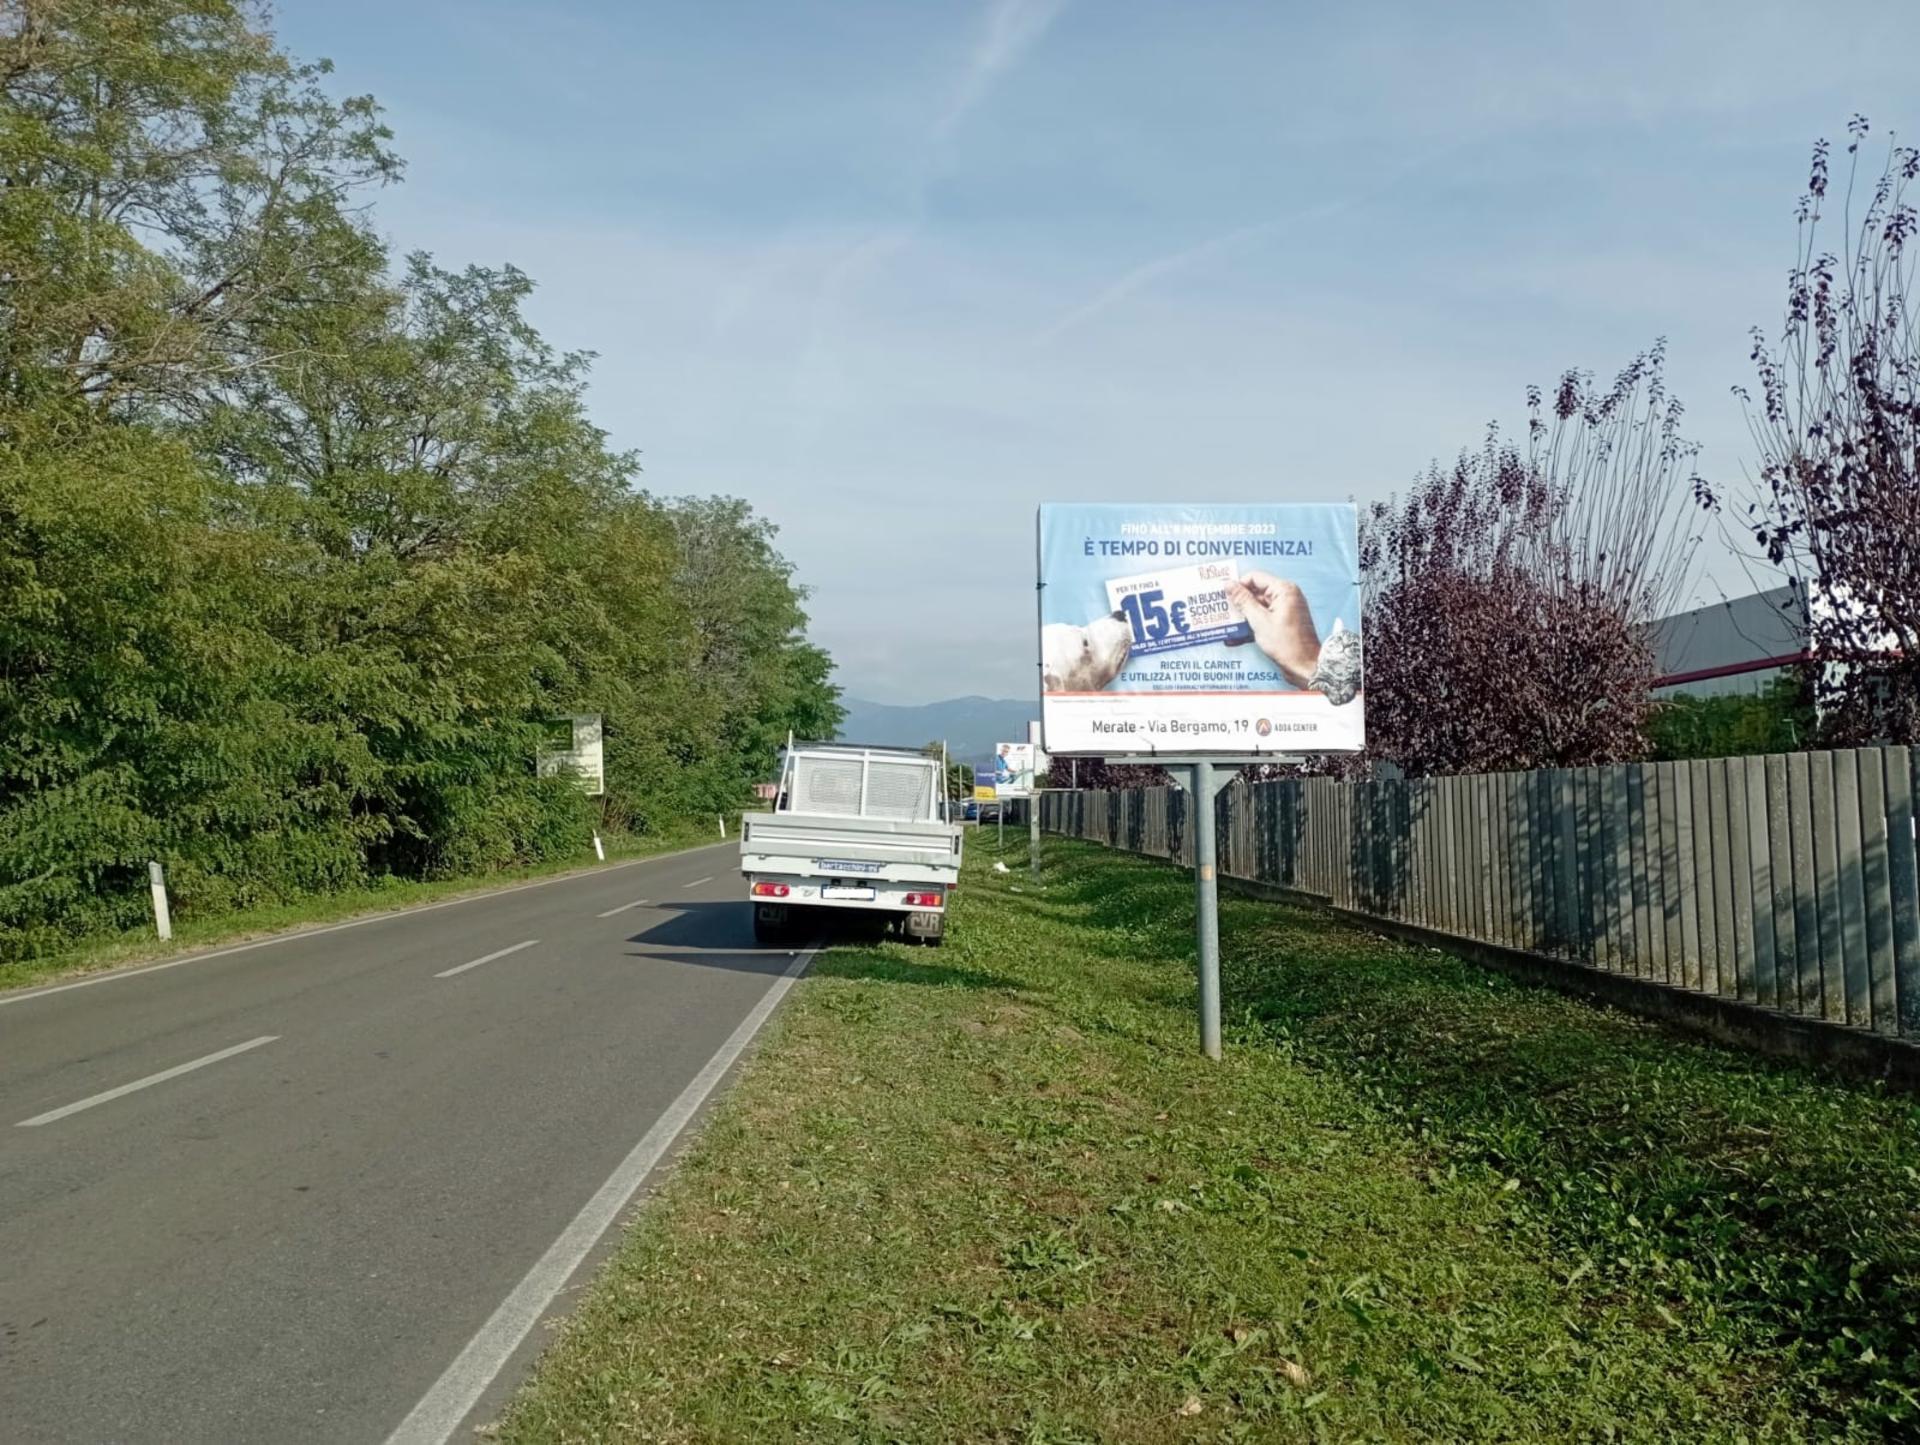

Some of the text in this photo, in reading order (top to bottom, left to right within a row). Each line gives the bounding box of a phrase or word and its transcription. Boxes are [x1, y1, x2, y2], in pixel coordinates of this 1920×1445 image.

[1121, 523, 1148, 535] FINO
[1182, 523, 1246, 535] NOVEMBRE
[1247, 523, 1276, 535] 2023
[1084, 536, 1312, 556] È TEMPO DI CONVENIENZA!
[1187, 589, 1227, 606] IN BUONI
[1189, 601, 1229, 618] SCONTO
[1160, 660, 1242, 670] RICEVI IL CARNET
[1121, 672, 1127, 681] E
[1129, 671, 1172, 681] UTILIZZA
[1178, 671, 1201, 681] TUOI
[1203, 671, 1233, 681] BUONI
[1235, 671, 1245, 681] IN
[1092, 720, 1136, 733] Merate
[1148, 720, 1167, 733] Via
[1170, 719, 1231, 736] Bergamo,
[1234, 719, 1249, 732] 19
[1293, 723, 1318, 732] CENTER
